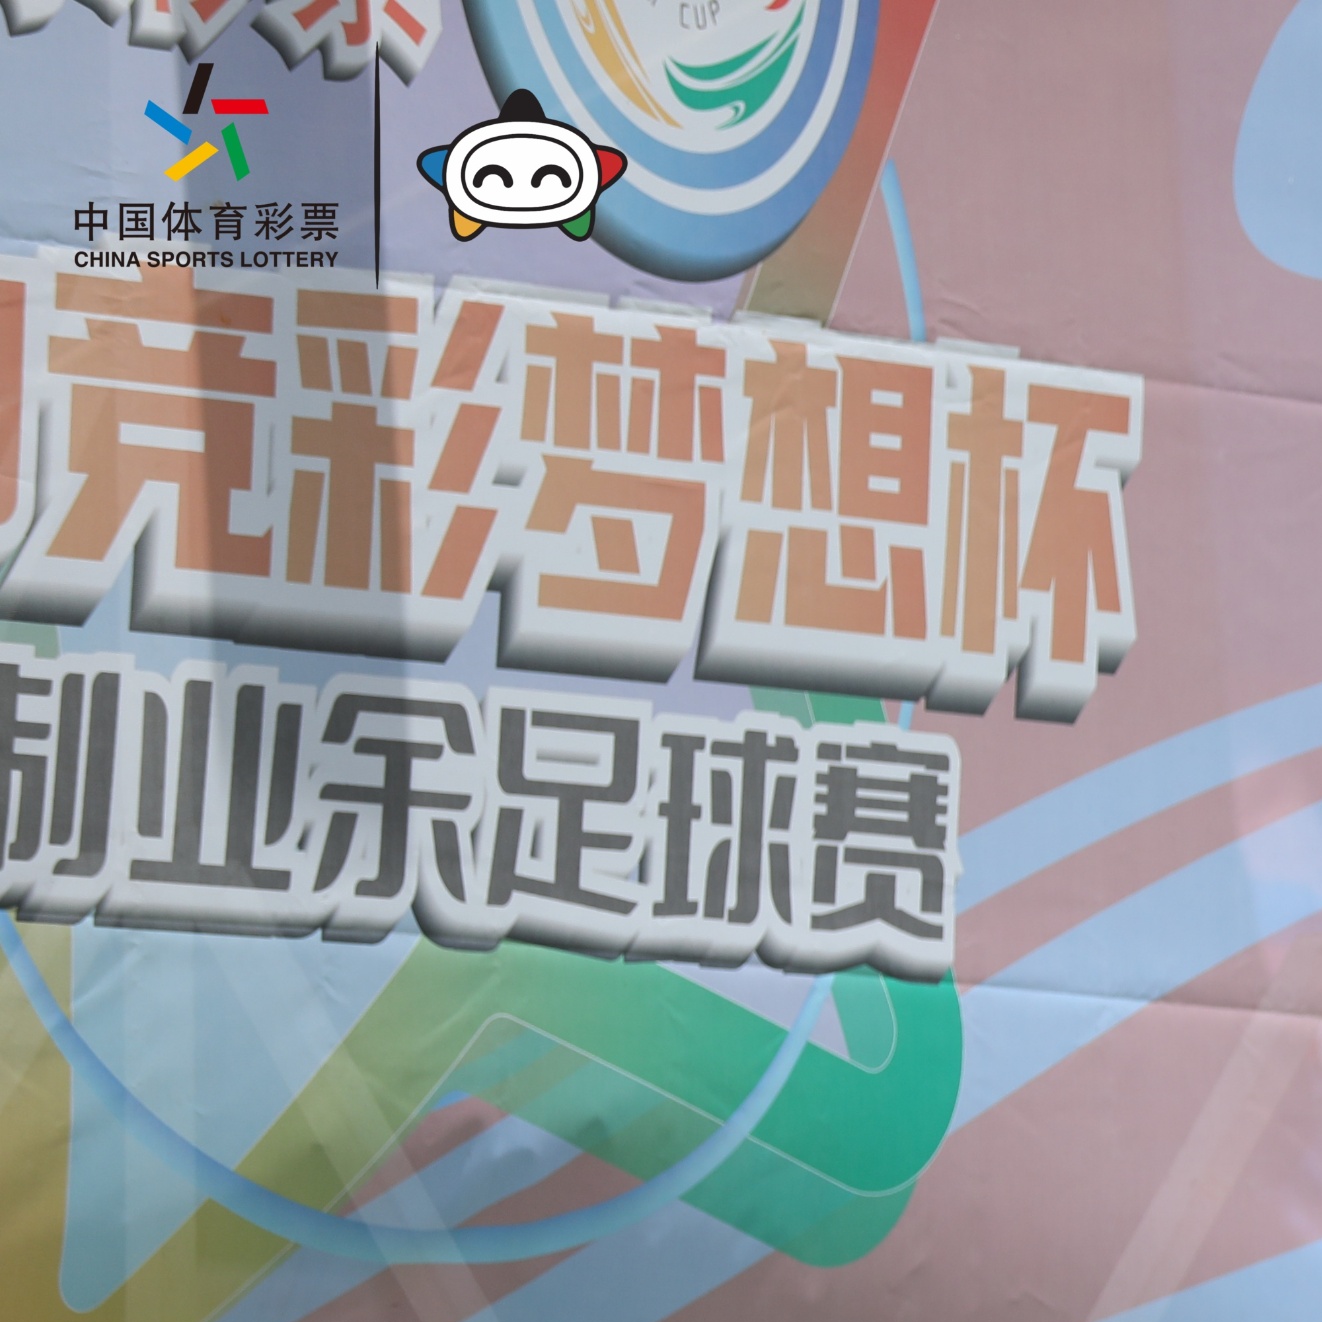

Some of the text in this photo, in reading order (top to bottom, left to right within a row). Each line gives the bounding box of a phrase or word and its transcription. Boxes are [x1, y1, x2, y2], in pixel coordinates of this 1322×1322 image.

[0, 264, 1132, 664] 竞彩梦想杯
